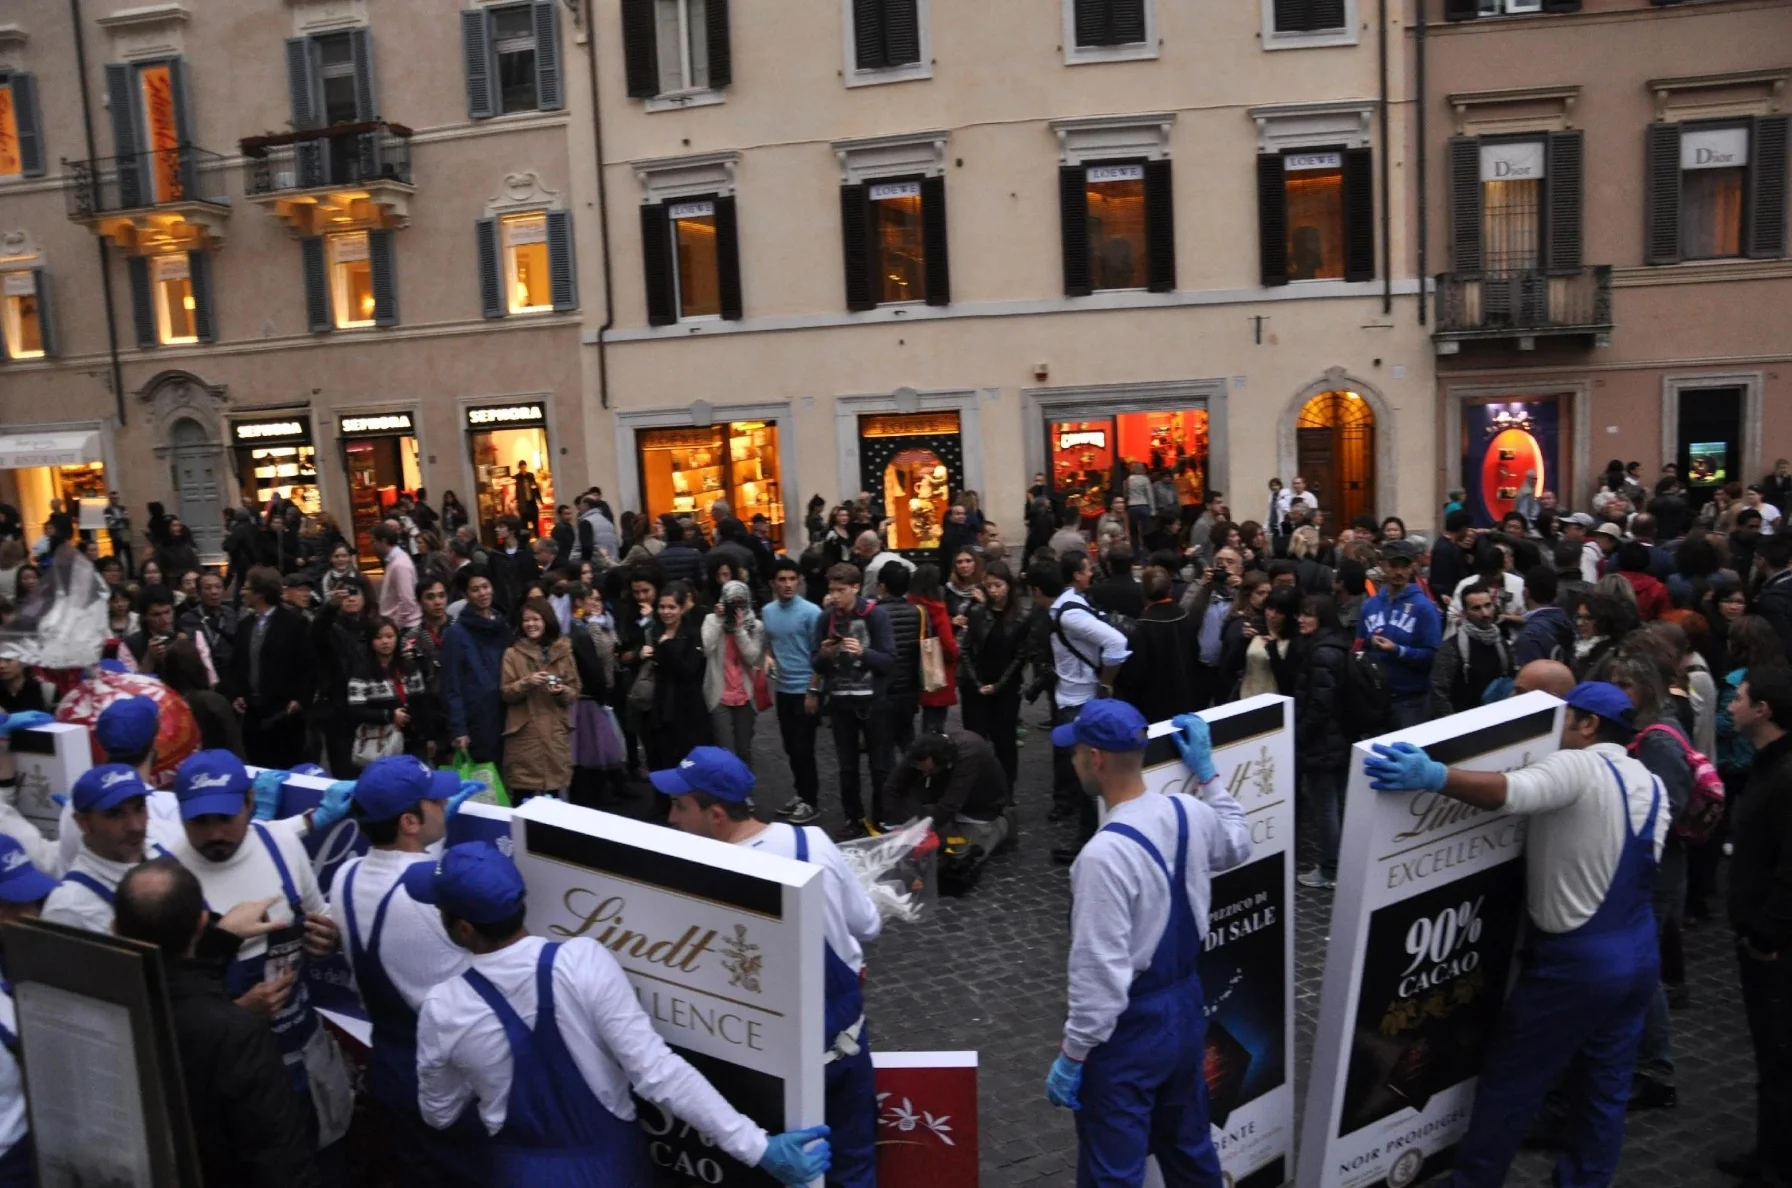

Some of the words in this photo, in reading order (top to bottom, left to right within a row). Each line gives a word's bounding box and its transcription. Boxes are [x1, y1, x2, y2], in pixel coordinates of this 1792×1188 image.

[1290, 155, 1337, 166] LOEWE
[1695, 147, 1735, 164] Dior
[1092, 167, 1138, 178] LOEWE
[1494, 161, 1531, 177] Dior
[875, 184, 918, 196] LOEWE
[468, 406, 543, 423] SEPHORA
[236, 422, 303, 438] SEPHORA
[341, 415, 412, 432] SEPHORA
[1386, 818, 1527, 890] EXCELLENCE
[547, 887, 718, 973] Lindt
[1203, 926, 1226, 953] DI
[1228, 905, 1277, 941] SALE
[1400, 894, 1485, 977] 90%
[1398, 950, 1480, 998] CACAO
[1340, 1147, 1380, 1176] NOIR
